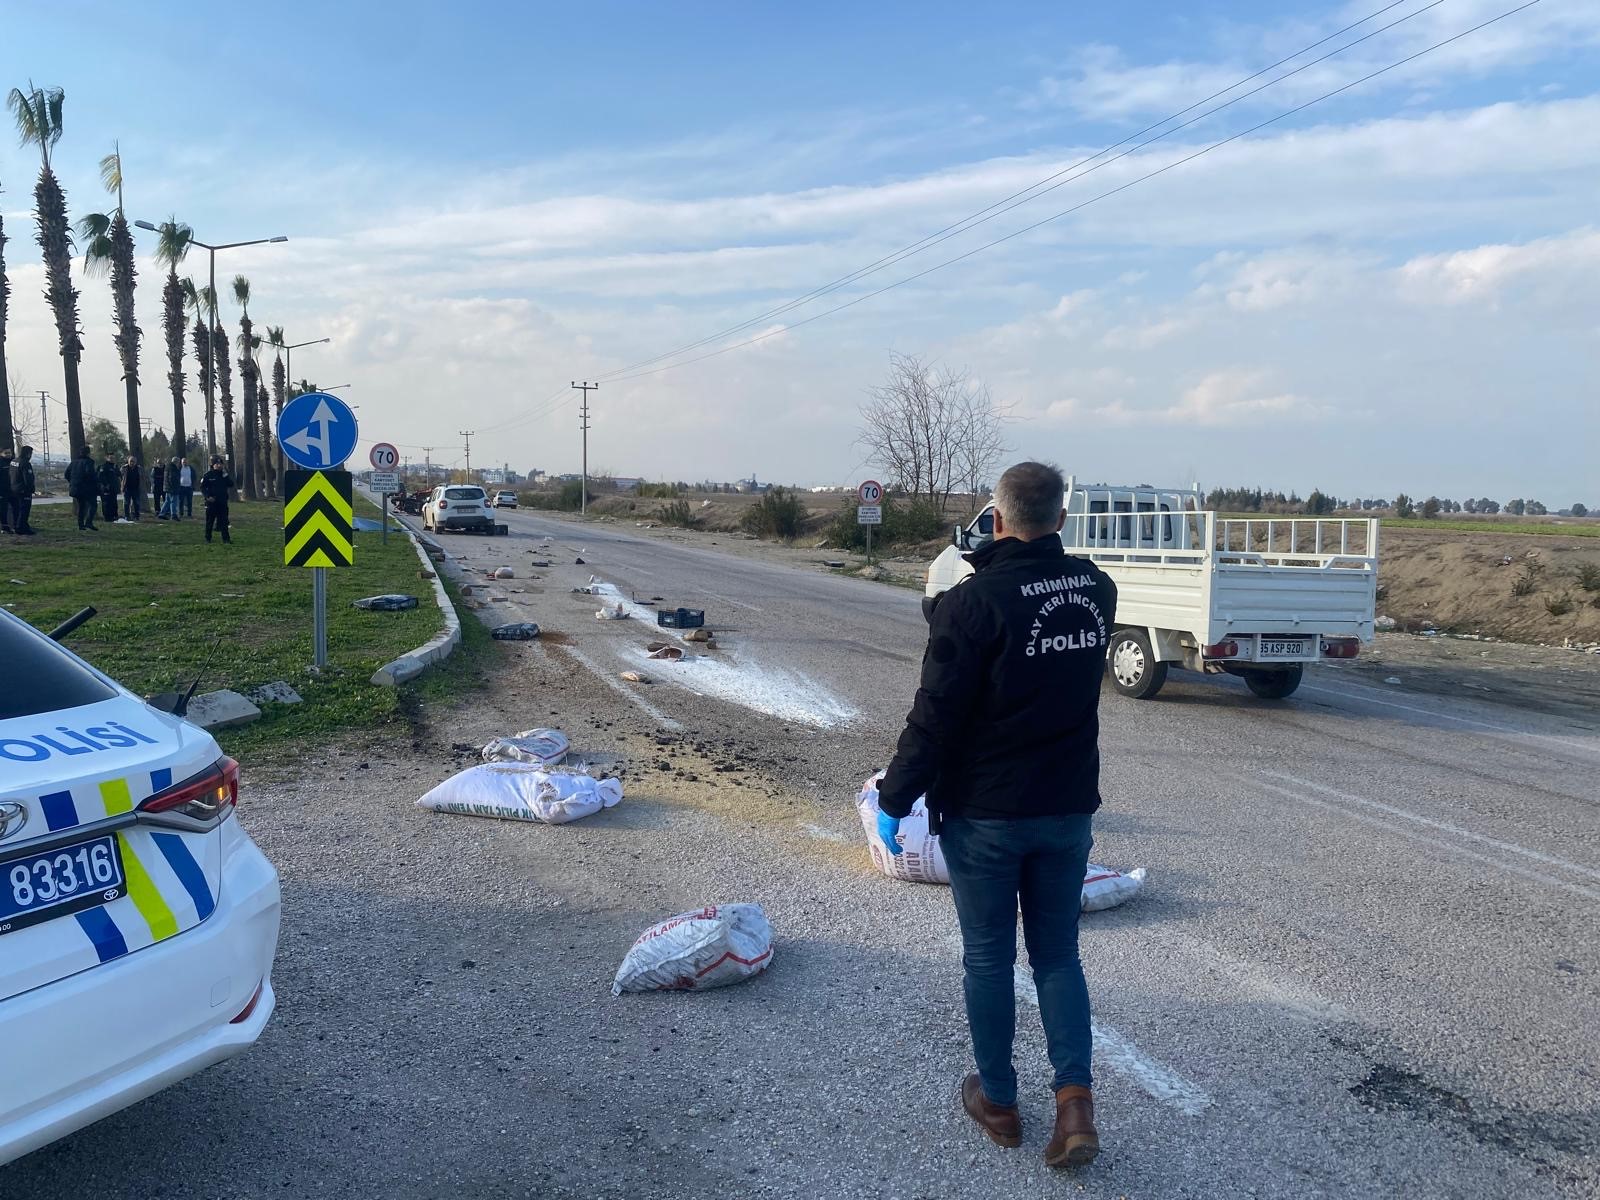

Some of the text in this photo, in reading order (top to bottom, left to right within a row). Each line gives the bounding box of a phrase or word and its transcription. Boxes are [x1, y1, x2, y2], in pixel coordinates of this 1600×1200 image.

[376, 450, 394, 464] 70
[864, 486, 879, 499] 70
[1020, 574, 1097, 597] KRİMİNAL
[1025, 590, 1106, 656] OLAY YERİ İNCELEME
[1041, 629, 1097, 654] POLİS
[1270, 643, 1285, 654] ASP
[1286, 643, 1301, 654] 920
[472, 803, 494, 816] TAM
[10, 844, 113, 906] 83316
